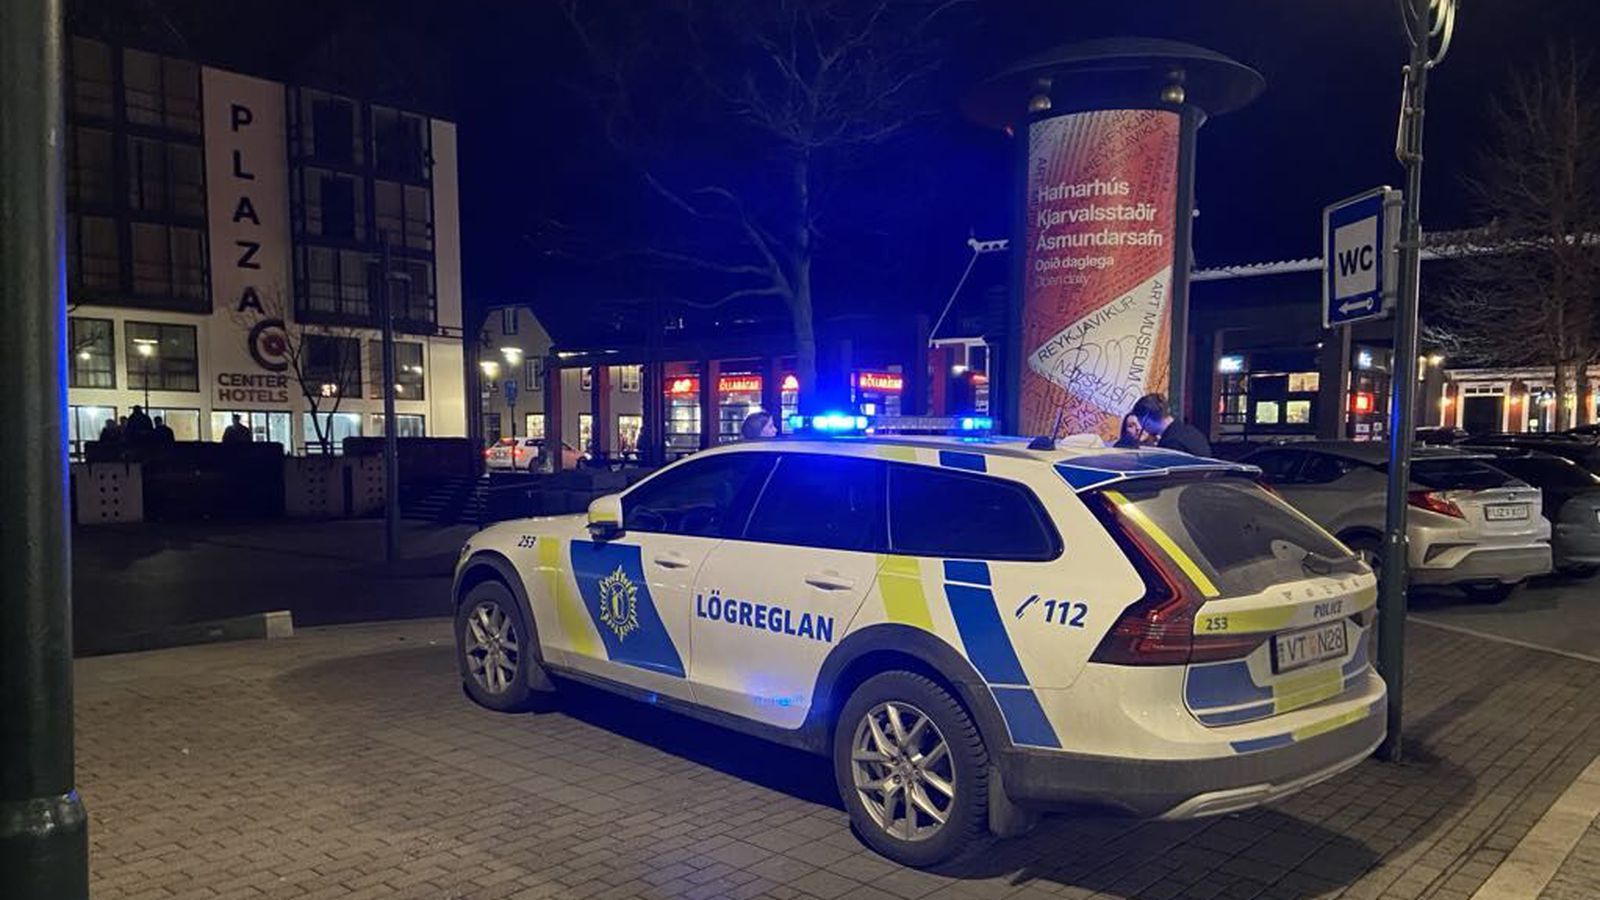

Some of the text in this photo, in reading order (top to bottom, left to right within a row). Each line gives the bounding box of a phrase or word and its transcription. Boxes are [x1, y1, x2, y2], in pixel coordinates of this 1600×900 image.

[1039, 177, 1130, 201] Hafnarhús
[231, 103, 265, 315] PLAZA
[1036, 203, 1157, 229] Kjarvalsstaðir
[1036, 229, 1163, 251] Ásmundarsafn
[1034, 255, 1114, 272] Opið daglega
[1338, 244, 1373, 277] WC
[1037, 295, 1137, 364] REYKJAVIKUR
[1128, 279, 1164, 382] ART MUSEUM
[217, 373, 289, 388] CENTER
[218, 389, 289, 403] HOTELS
[517, 535, 537, 549] 253
[696, 590, 834, 643] LÖGREGLAN
[1044, 600, 1088, 628] 112
[1313, 600, 1344, 619] POLICE
[1206, 617, 1229, 631] 253
[1287, 635, 1307, 661] VT
[1317, 626, 1344, 656] N28
